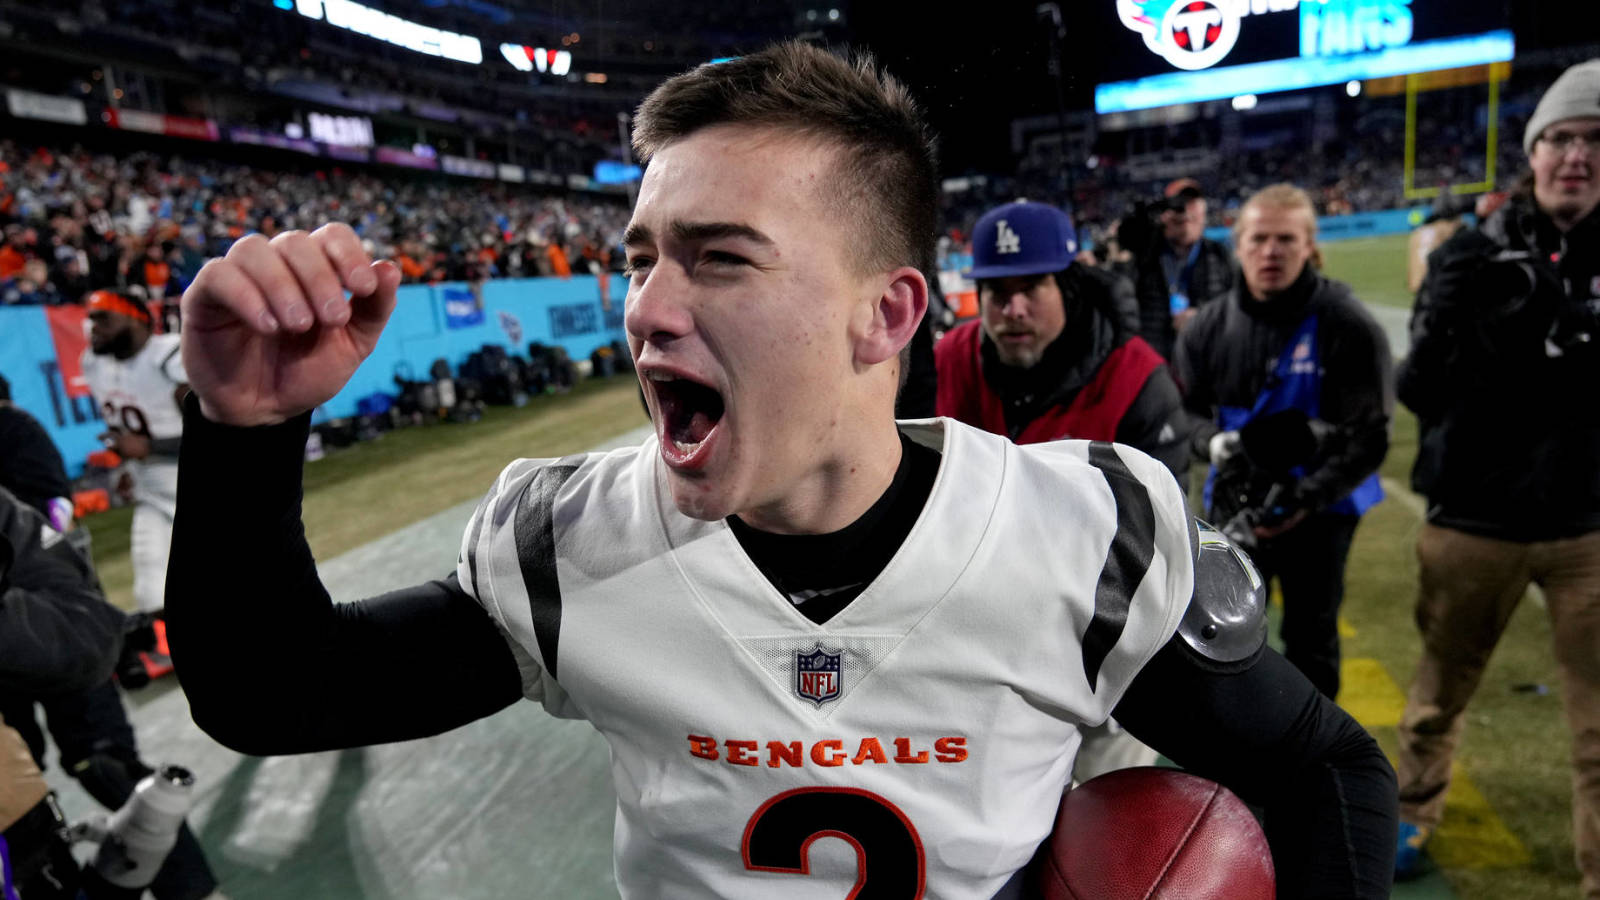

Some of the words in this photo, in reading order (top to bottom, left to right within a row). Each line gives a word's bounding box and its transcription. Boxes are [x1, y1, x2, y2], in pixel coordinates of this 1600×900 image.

[996, 220, 1020, 254] LA
[801, 672, 837, 697] NFL
[687, 734, 969, 768] BENGALS
